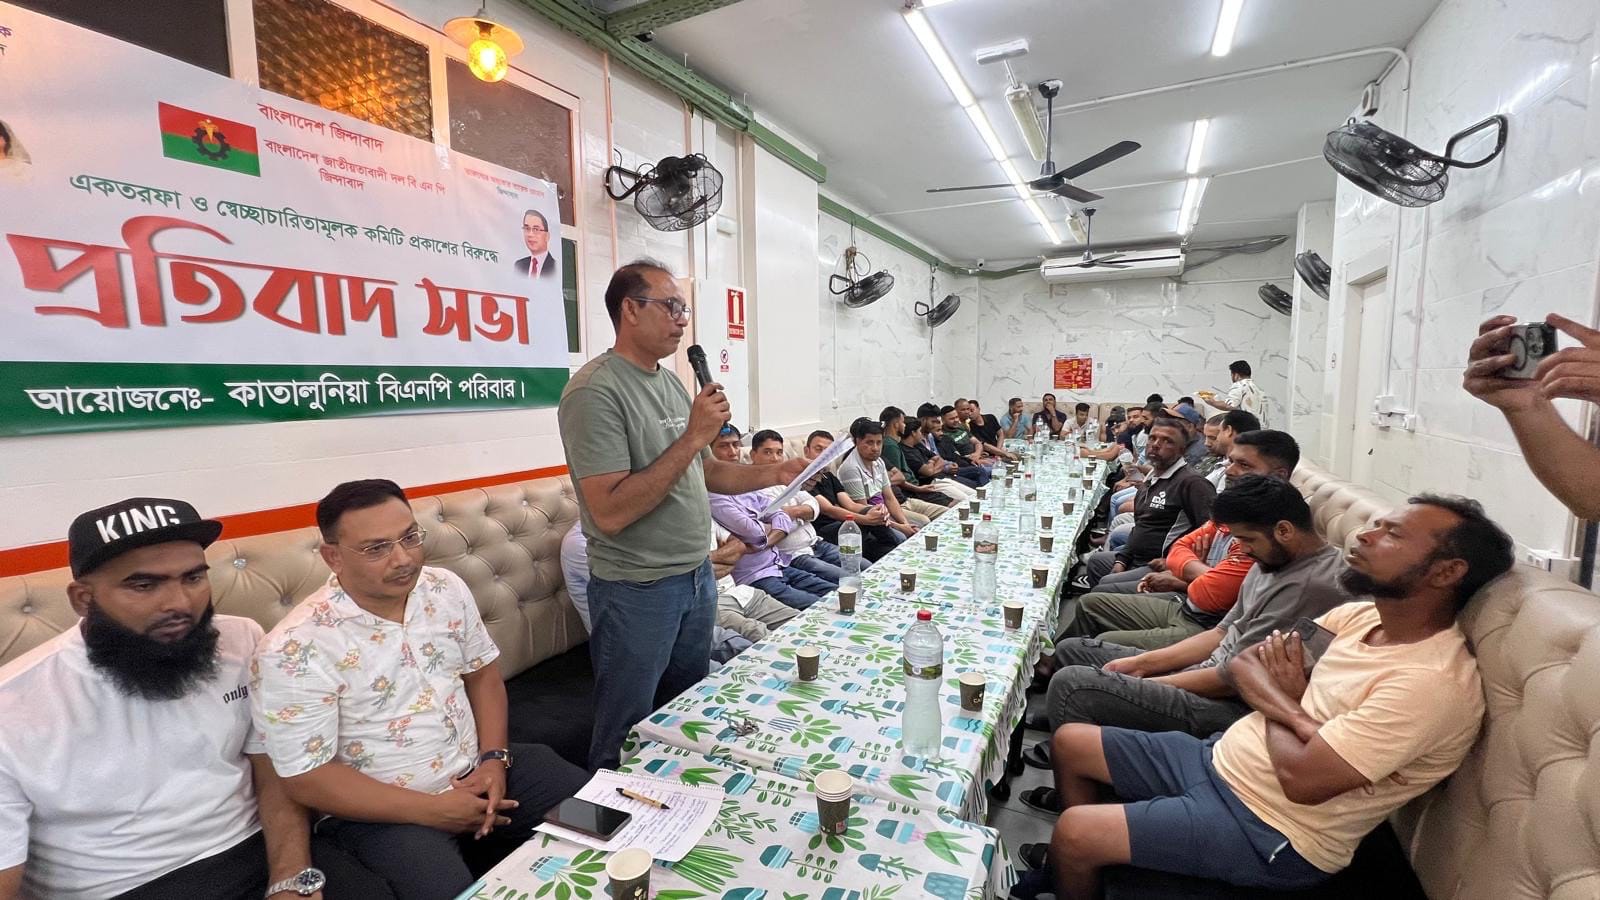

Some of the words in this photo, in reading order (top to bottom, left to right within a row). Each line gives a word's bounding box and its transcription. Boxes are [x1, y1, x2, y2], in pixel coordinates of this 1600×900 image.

[257, 103, 326, 136] বাংলাদেশ
[329, 121, 385, 153] জিন্দাবাদ
[263, 139, 320, 164] বাংলাদেশ
[318, 168, 365, 190] জিন্দাবাদ
[69, 174, 184, 209] একতরফা
[190, 196, 209, 212] ও
[216, 200, 358, 241] স্বেচ্ছাচারিতামূলক
[362, 224, 405, 246] কমিটি
[409, 235, 459, 257] প্রকাশের
[461, 241, 499, 264] বিরুদ্ধে
[6, 215, 398, 338] প্রতিবাদ
[415, 277, 530, 345] সভা
[223, 372, 371, 412] কাতালুনিয়া
[375, 372, 452, 403] বিএনপি
[95, 505, 181, 544] KING
[222, 683, 249, 704] only
